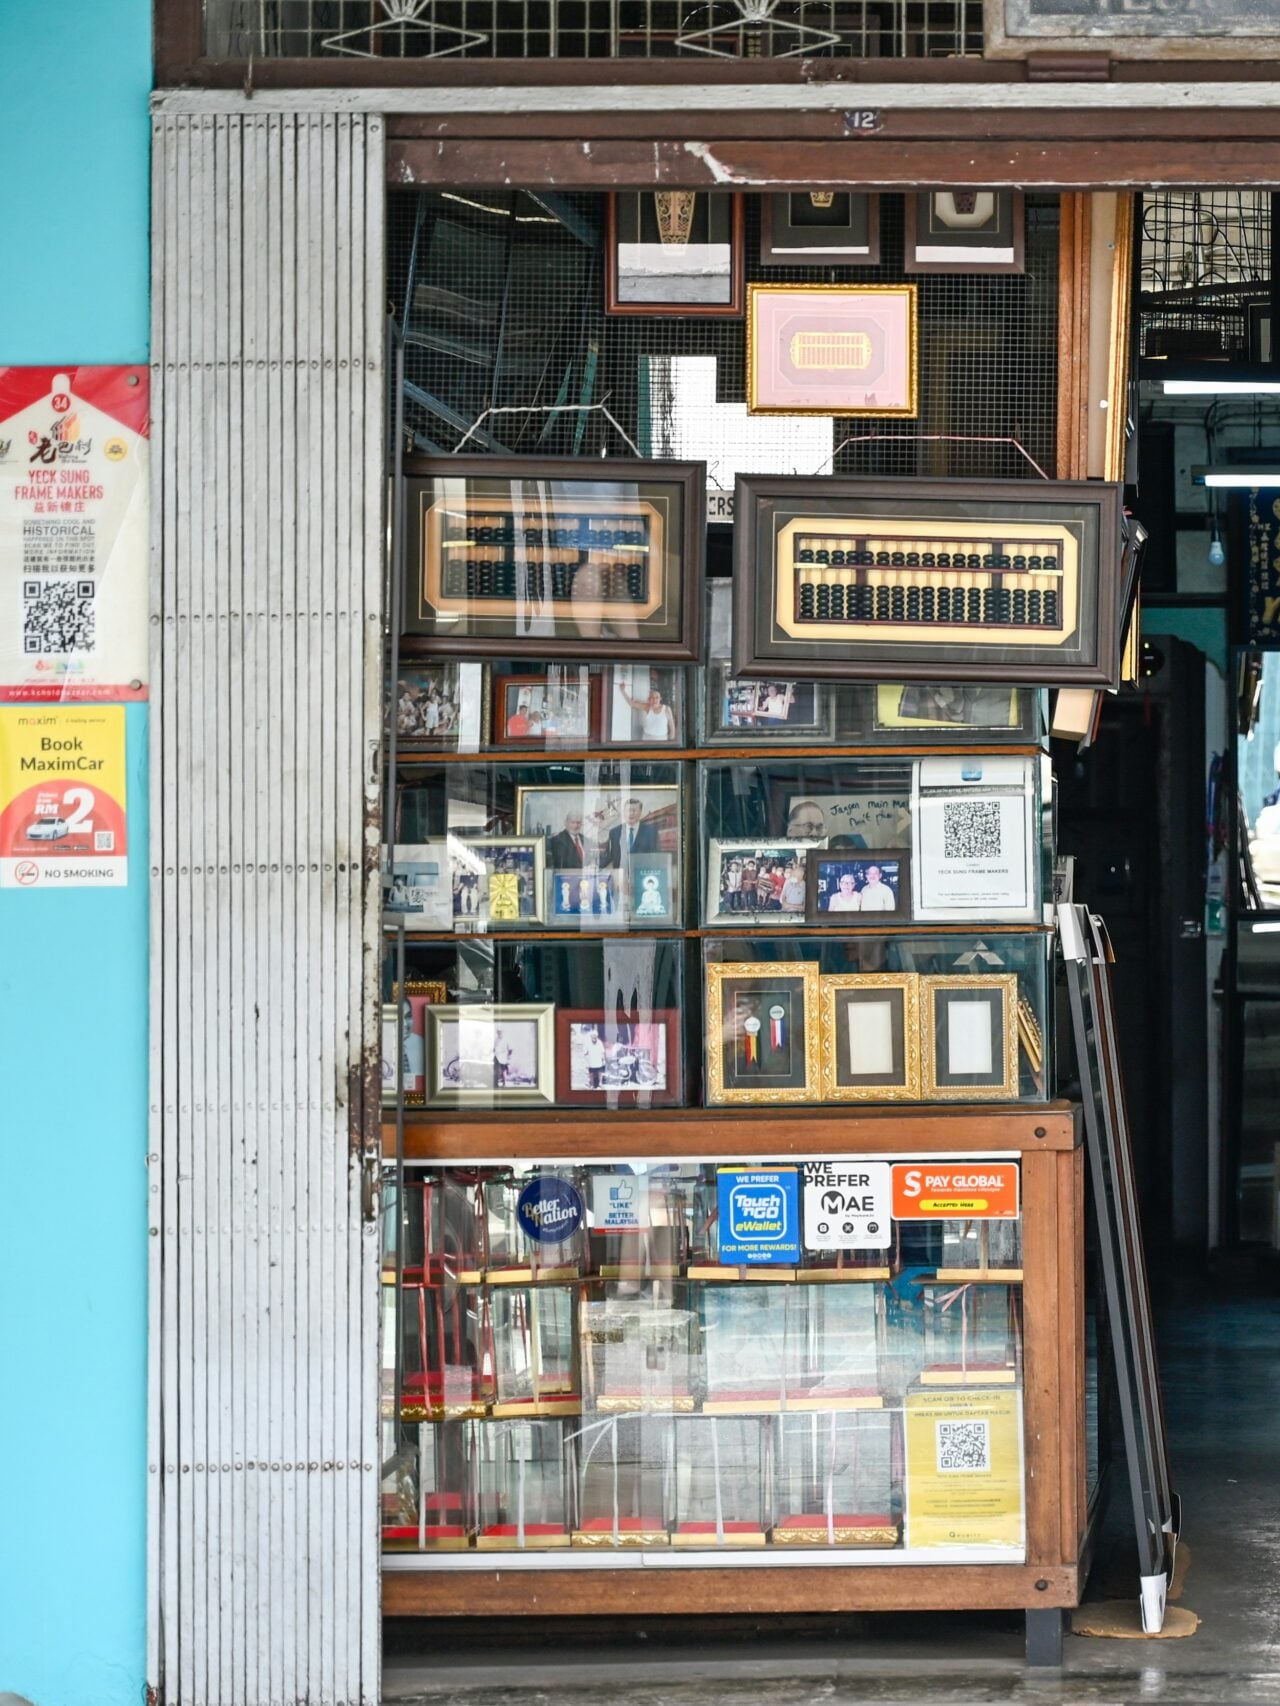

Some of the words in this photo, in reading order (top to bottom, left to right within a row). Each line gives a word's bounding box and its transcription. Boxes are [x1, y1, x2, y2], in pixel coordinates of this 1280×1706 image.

[853, 111, 874, 128] 12
[54, 397, 68, 409] 34
[28, 470, 57, 484] YECK
[60, 470, 90, 484] SUNG
[14, 486, 53, 500] FRAME
[56, 485, 104, 500] MAKERS
[23, 526, 95, 536] HISTORICAL
[41, 737, 83, 751] Book
[20, 757, 105, 771] MaximCar
[35, 804, 59, 814] RM
[63, 788, 95, 833] 2
[45, 869, 61, 878] NO
[64, 868, 114, 878] SMOKING
[806, 1163, 833, 1174] WE
[750, 1175, 780, 1183] PREFER
[804, 1174, 870, 1188] PREFER
[903, 1171, 923, 1197] S
[925, 1175, 950, 1187] PAY
[952, 1175, 1004, 1187] GLOBAL
[734, 1195, 781, 1207] Touch
[821, 1191, 875, 1215] MAE
[735, 1221, 782, 1232] eWallet
[722, 1244, 736, 1252] FOR
[738, 1244, 759, 1252] MORE
